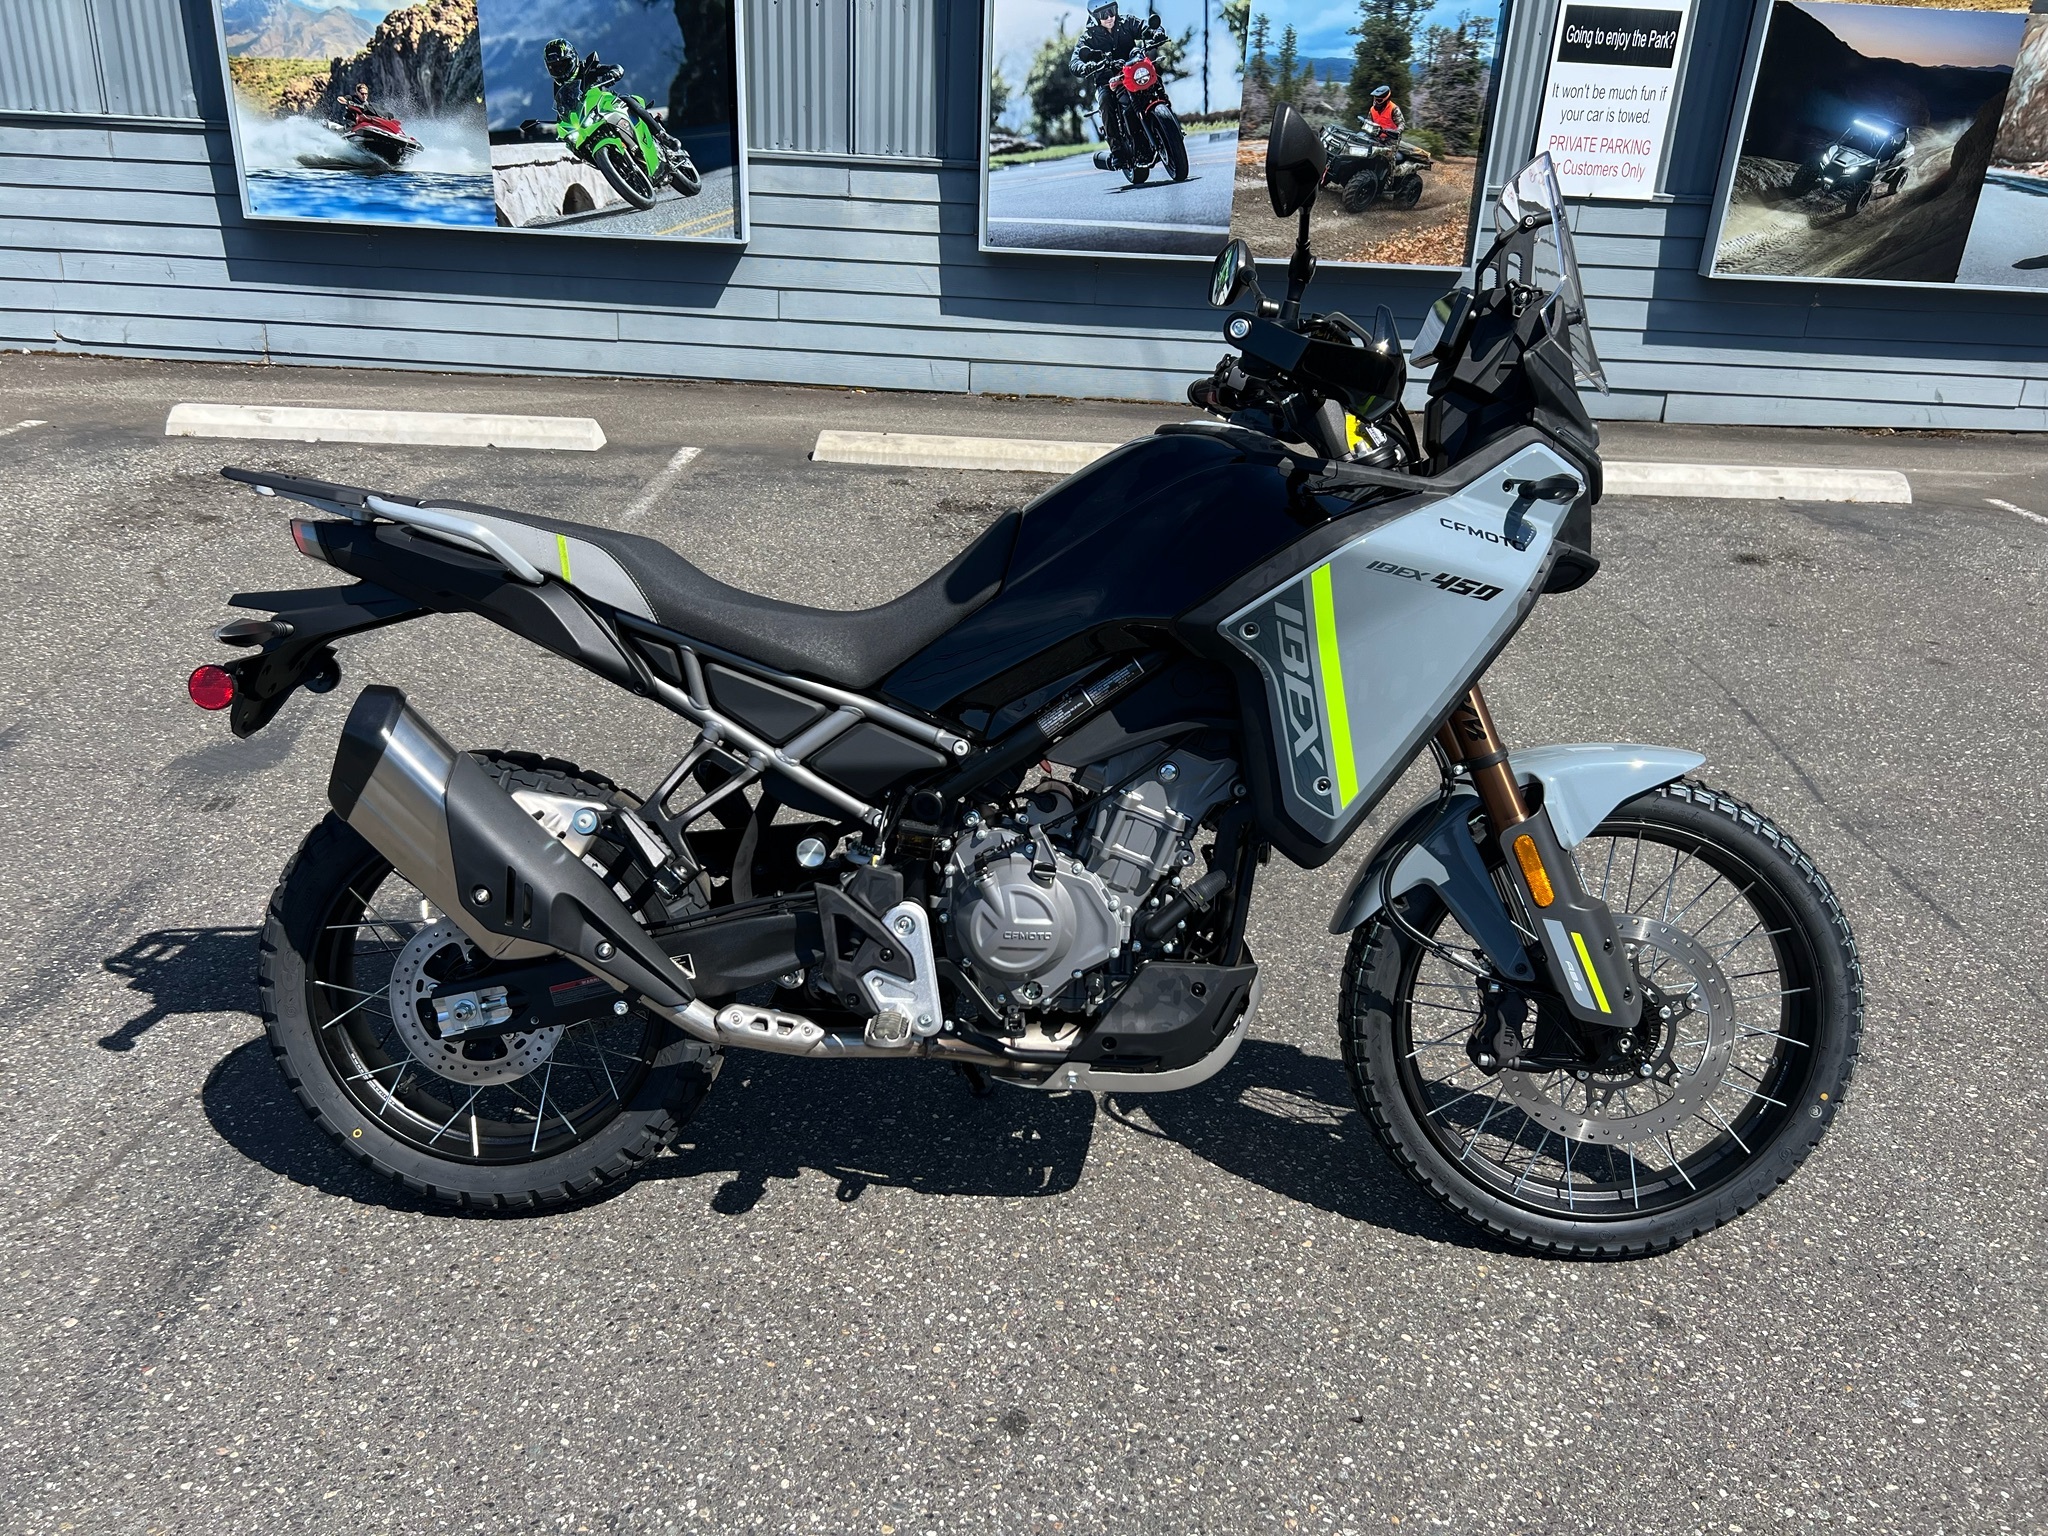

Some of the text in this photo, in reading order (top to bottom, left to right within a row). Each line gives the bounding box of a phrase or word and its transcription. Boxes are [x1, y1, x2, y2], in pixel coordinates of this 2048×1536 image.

[1566, 24, 1676, 51] Going to enjoy the Park?
[1552, 82, 1668, 102] It won't be much fun if
[1560, 107, 1651, 125] your car is towed.
[1548, 135, 1652, 156] PRIVATE PARKING
[1563, 159, 1619, 178] Customers
[1621, 162, 1646, 183] Only
[1439, 517, 1527, 552] CFMOTO
[1365, 560, 1504, 602] IBEX 450
[1274, 601, 1325, 771] IBEX
[1003, 931, 1052, 941] CFMOTO
